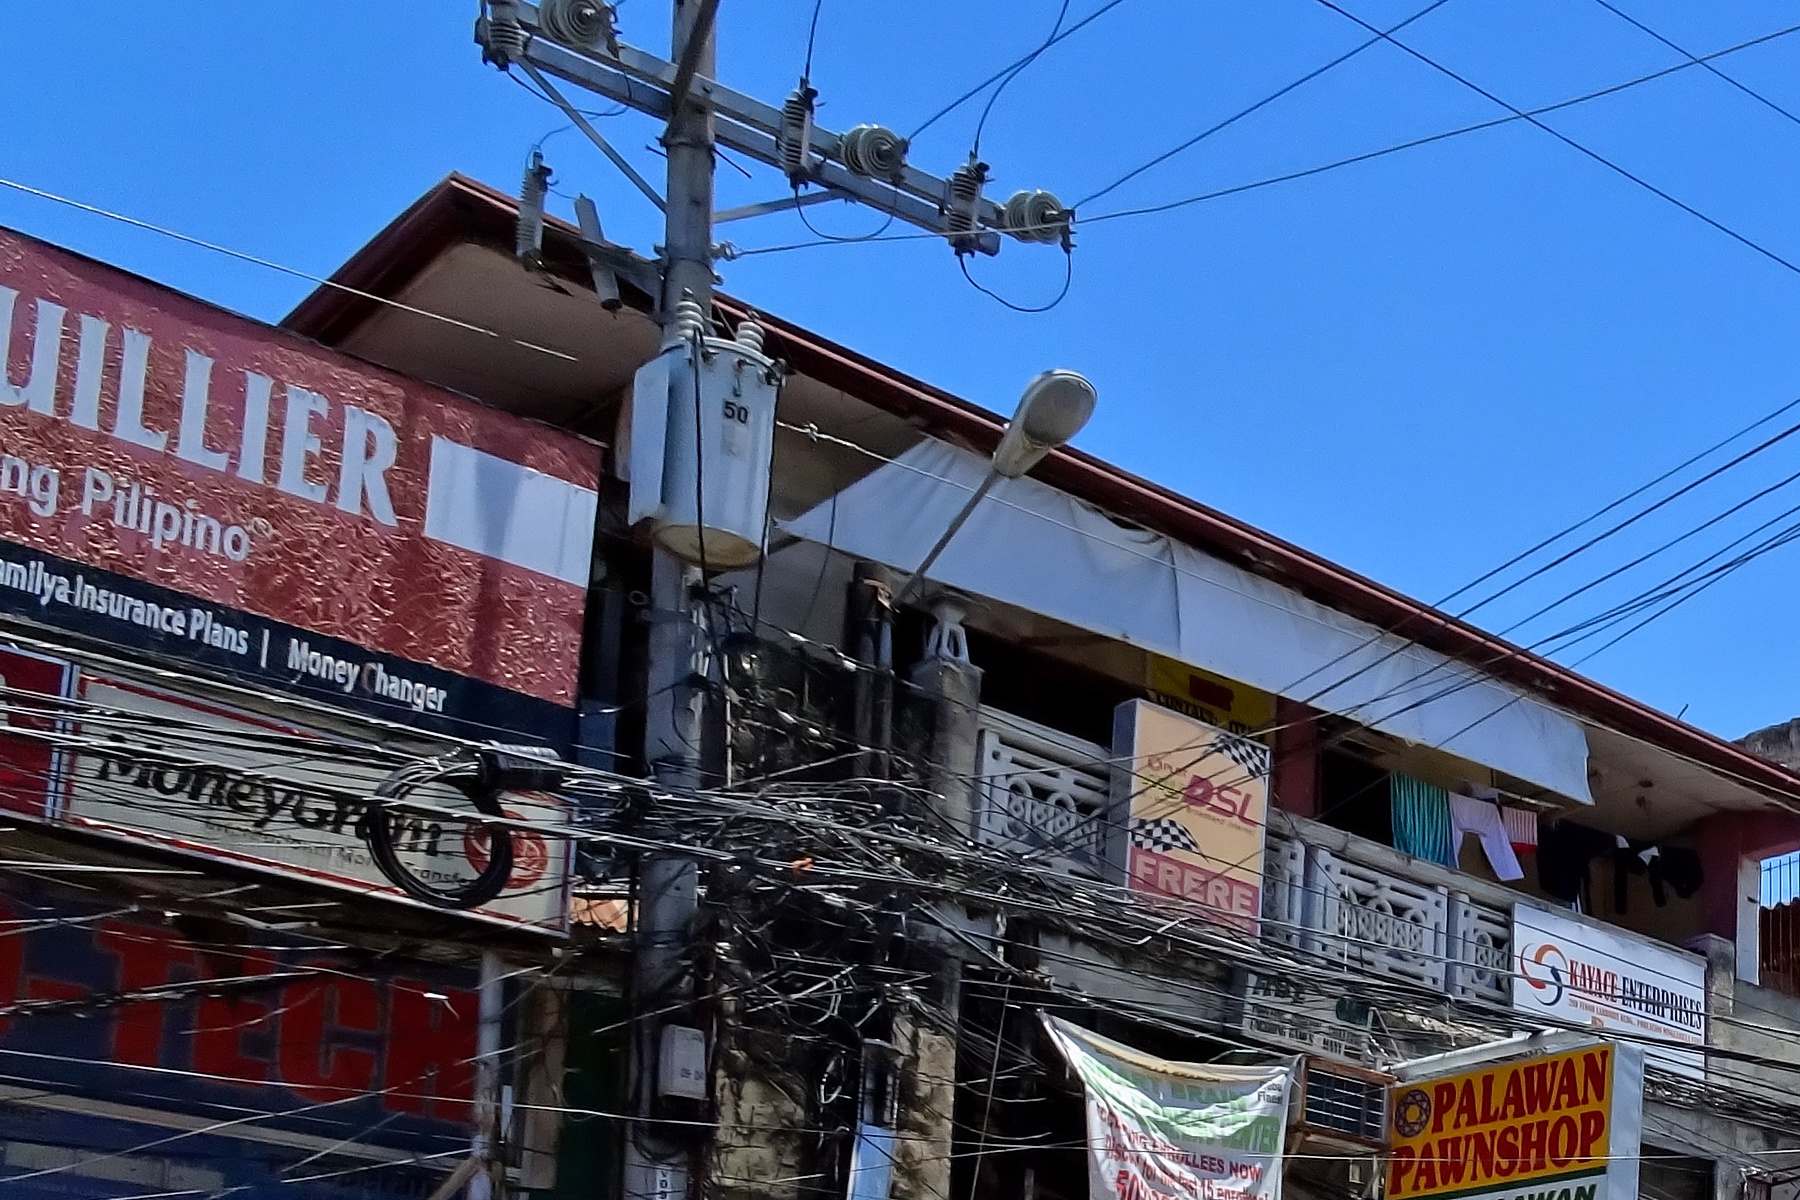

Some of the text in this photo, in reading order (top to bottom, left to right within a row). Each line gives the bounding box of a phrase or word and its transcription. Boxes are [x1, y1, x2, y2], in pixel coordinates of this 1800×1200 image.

[723, 400, 749, 426] 50
[81, 466, 251, 563] Pilipino
[75, 574, 185, 636] Insurance
[189, 607, 249, 656] Plans
[287, 636, 360, 693] Money
[1182, 775, 1258, 828] DSL
[1135, 853, 1252, 915] FRERE
[1621, 975, 1702, 1031] ENTERPRISES
[1431, 1050, 1610, 1135] PALAWAN
[1388, 1110, 1606, 1196] PAWNSHOP
